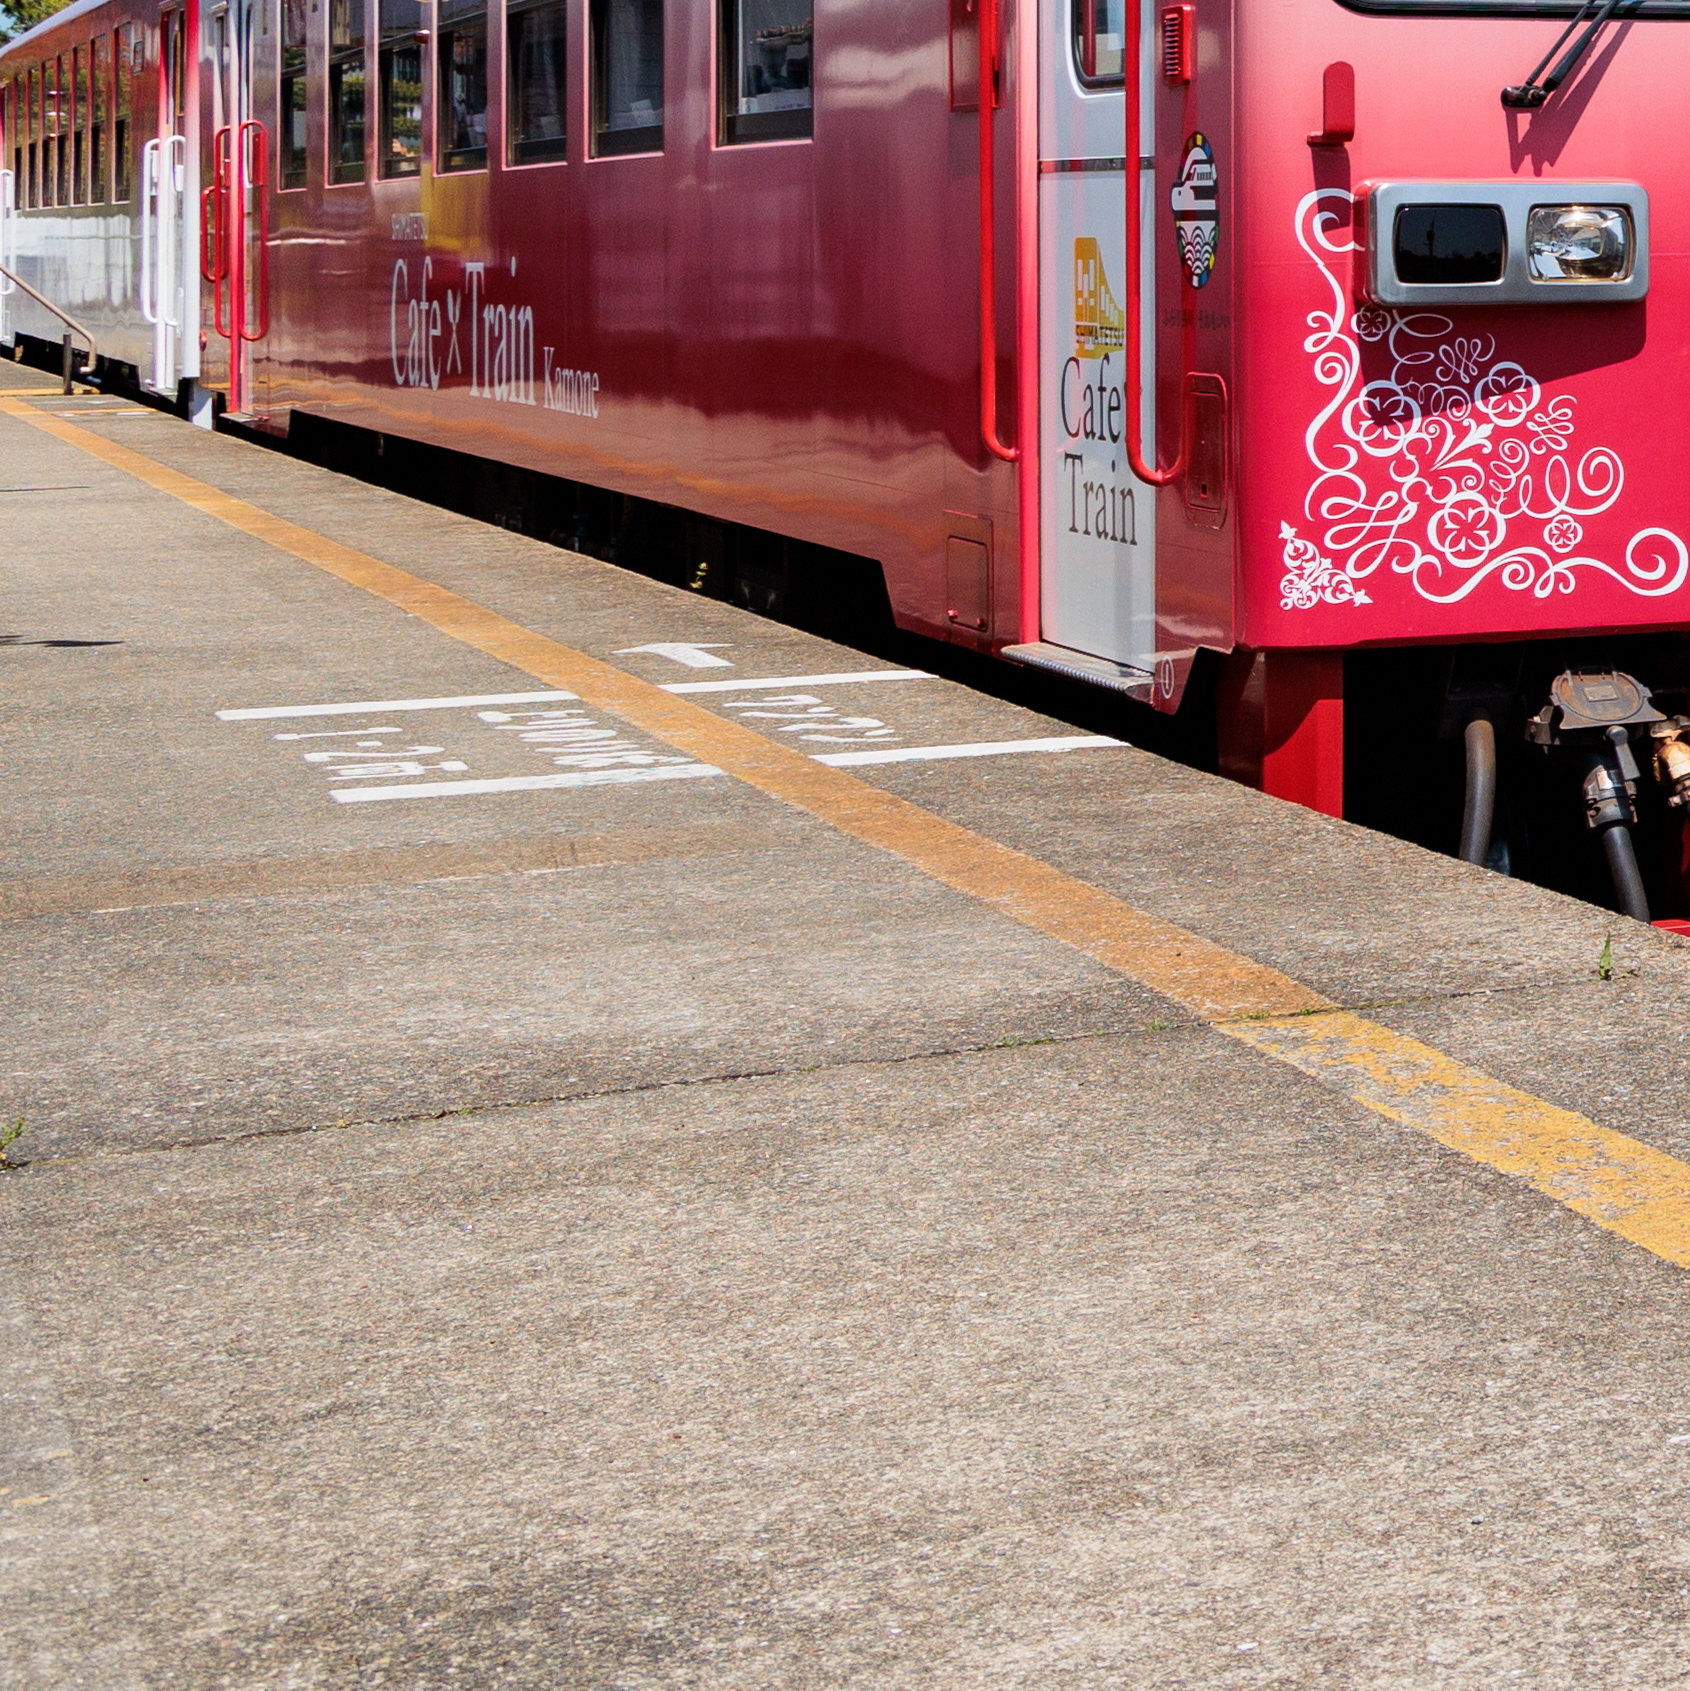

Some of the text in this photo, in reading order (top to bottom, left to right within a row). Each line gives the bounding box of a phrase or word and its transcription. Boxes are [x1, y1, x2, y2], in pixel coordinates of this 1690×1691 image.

[391, 256, 599, 419] Cafe Train Kamone
[1061, 353, 1121, 444] Cafe
[1064, 451, 1138, 546] Train
